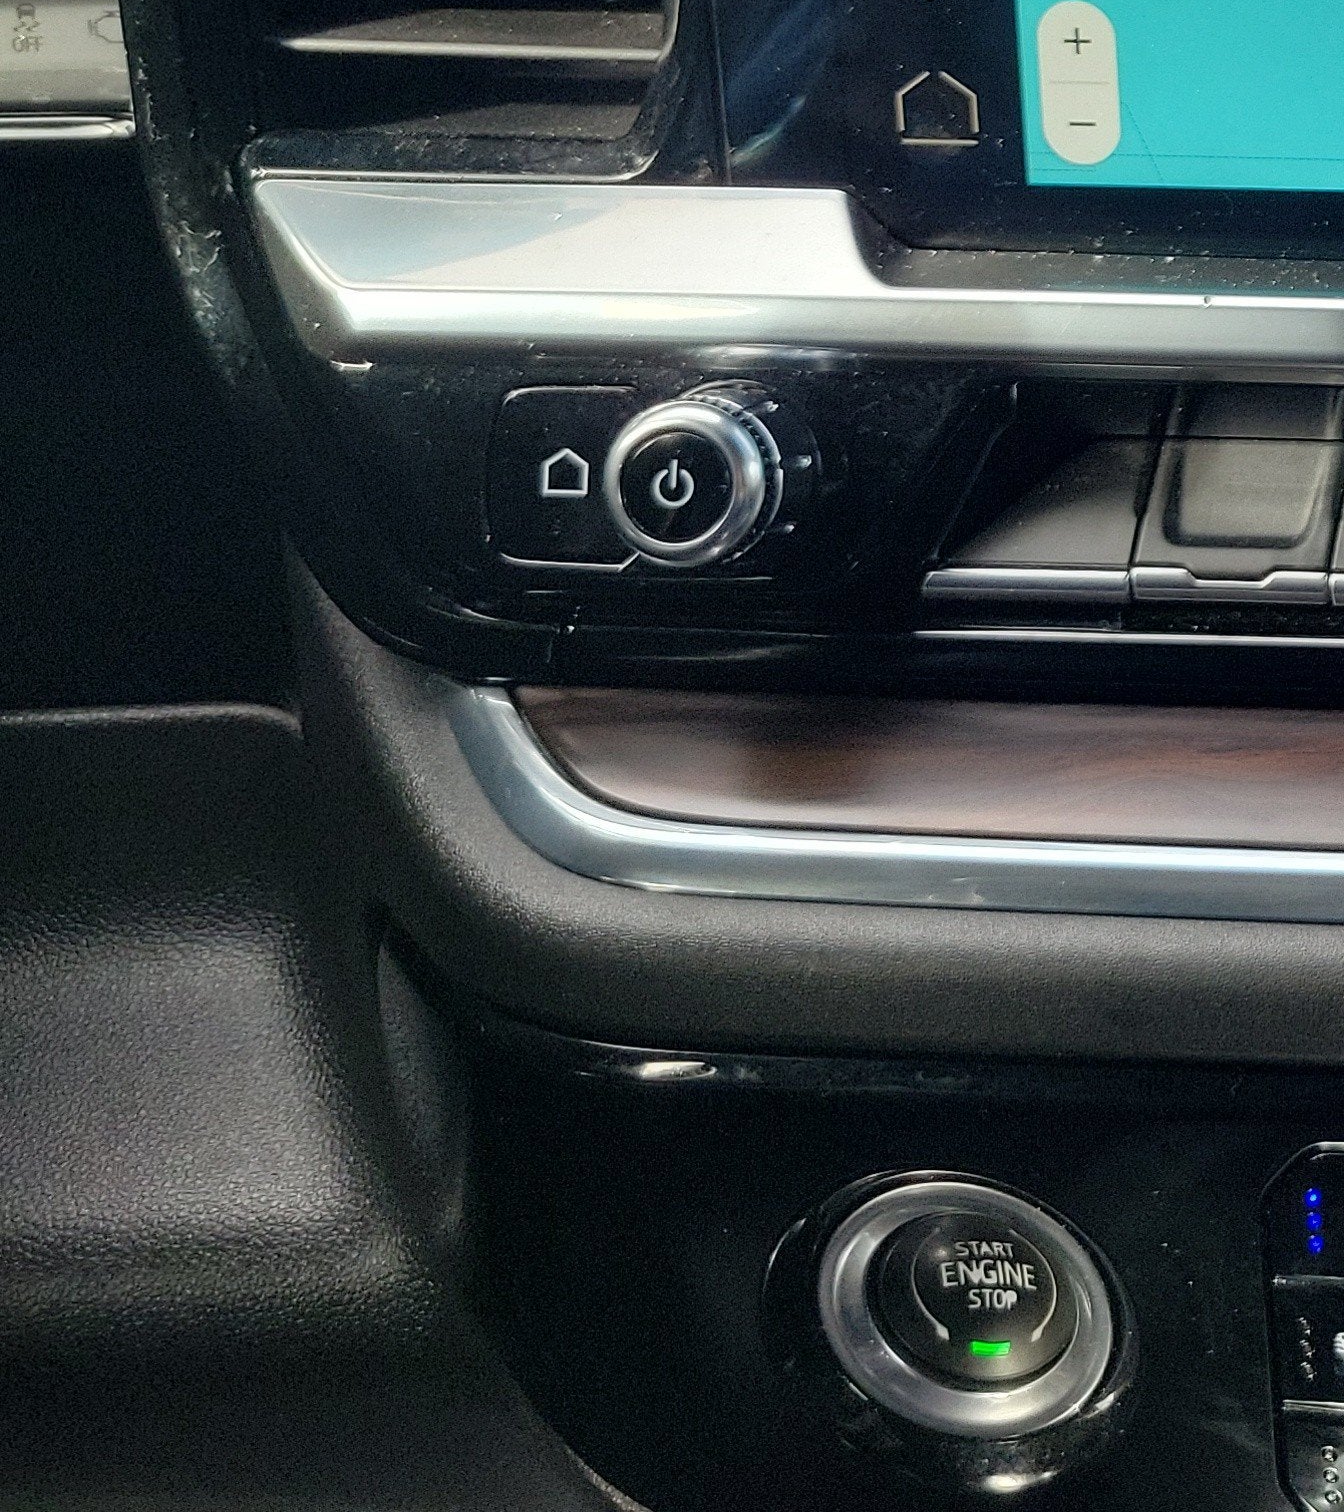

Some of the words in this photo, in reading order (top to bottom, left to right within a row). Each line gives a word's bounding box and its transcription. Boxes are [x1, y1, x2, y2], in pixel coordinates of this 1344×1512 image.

[953, 1241, 1014, 1259] START
[940, 1260, 1038, 1291] ENGINE
[967, 1289, 1018, 1311] STOP
